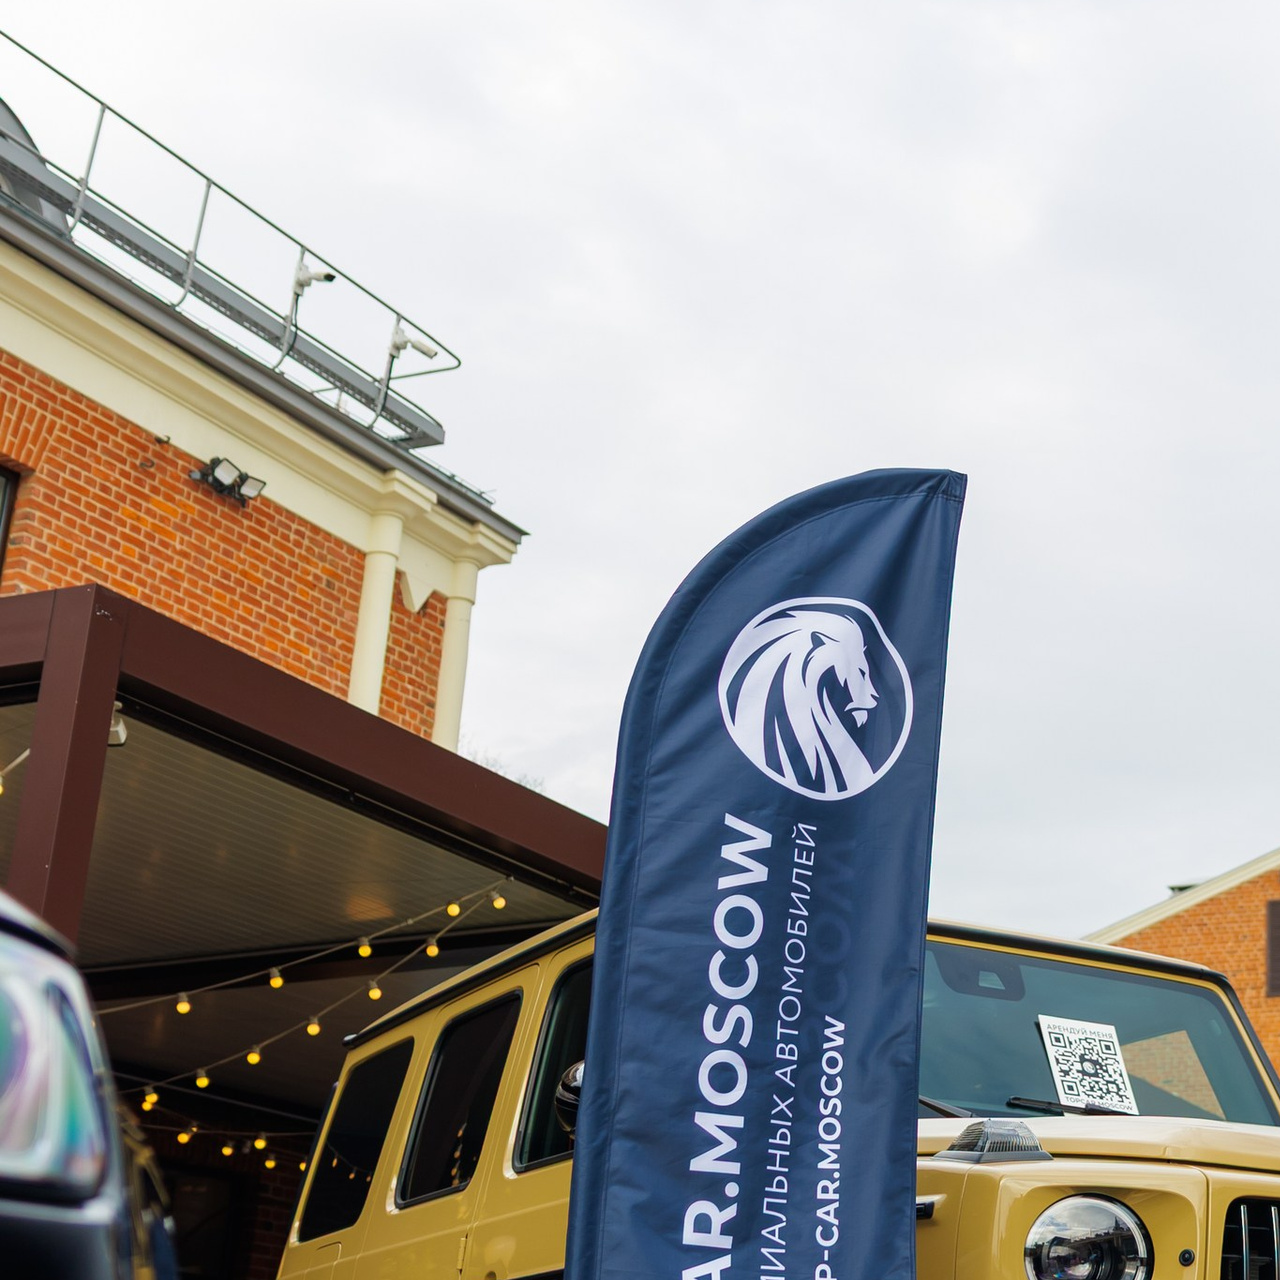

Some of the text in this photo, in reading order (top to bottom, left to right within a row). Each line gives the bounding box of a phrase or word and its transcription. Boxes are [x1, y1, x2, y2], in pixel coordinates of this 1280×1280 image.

[774, 822, 818, 1087] АВТОМОБИЛЕЙ
[1047, 1023, 1114, 1039] АРЕНДУЙ МЕНЯ
